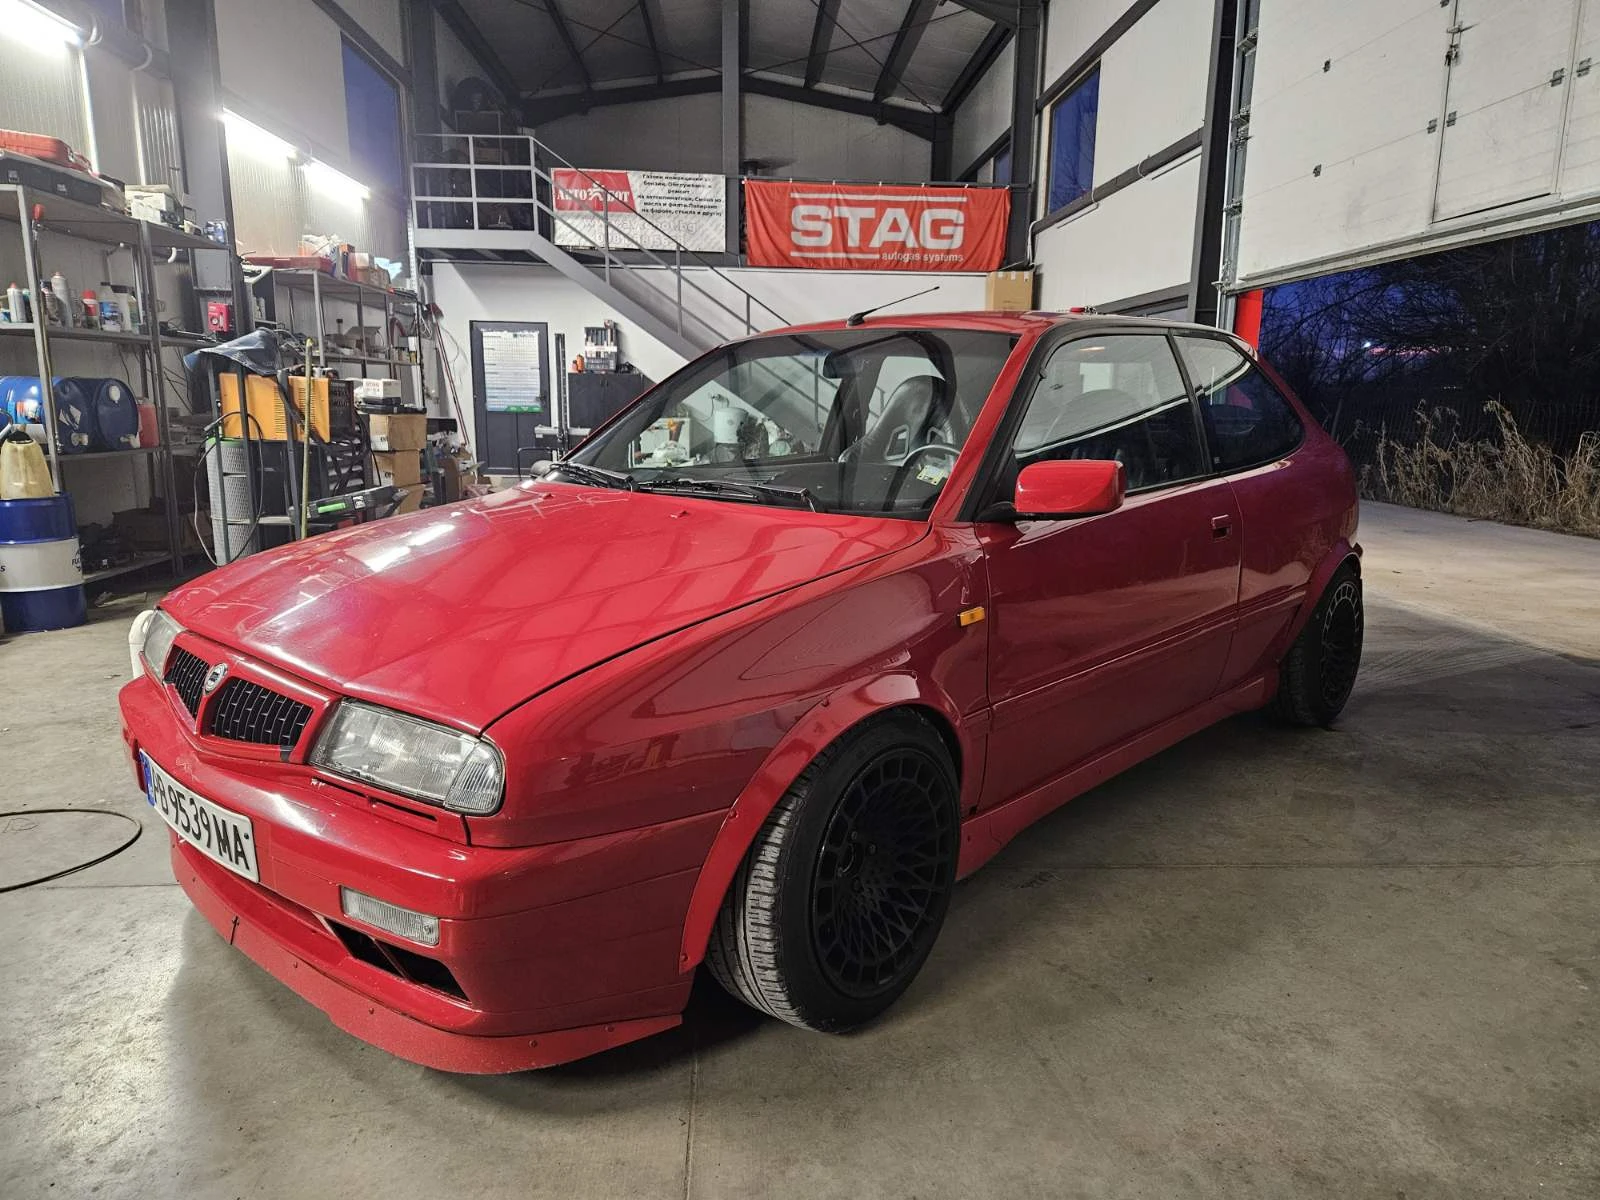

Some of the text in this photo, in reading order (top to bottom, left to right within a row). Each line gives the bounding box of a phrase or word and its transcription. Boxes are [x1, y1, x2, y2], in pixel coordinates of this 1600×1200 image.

[790, 204, 965, 250] STAG
[882, 252, 964, 264] autogas systems
